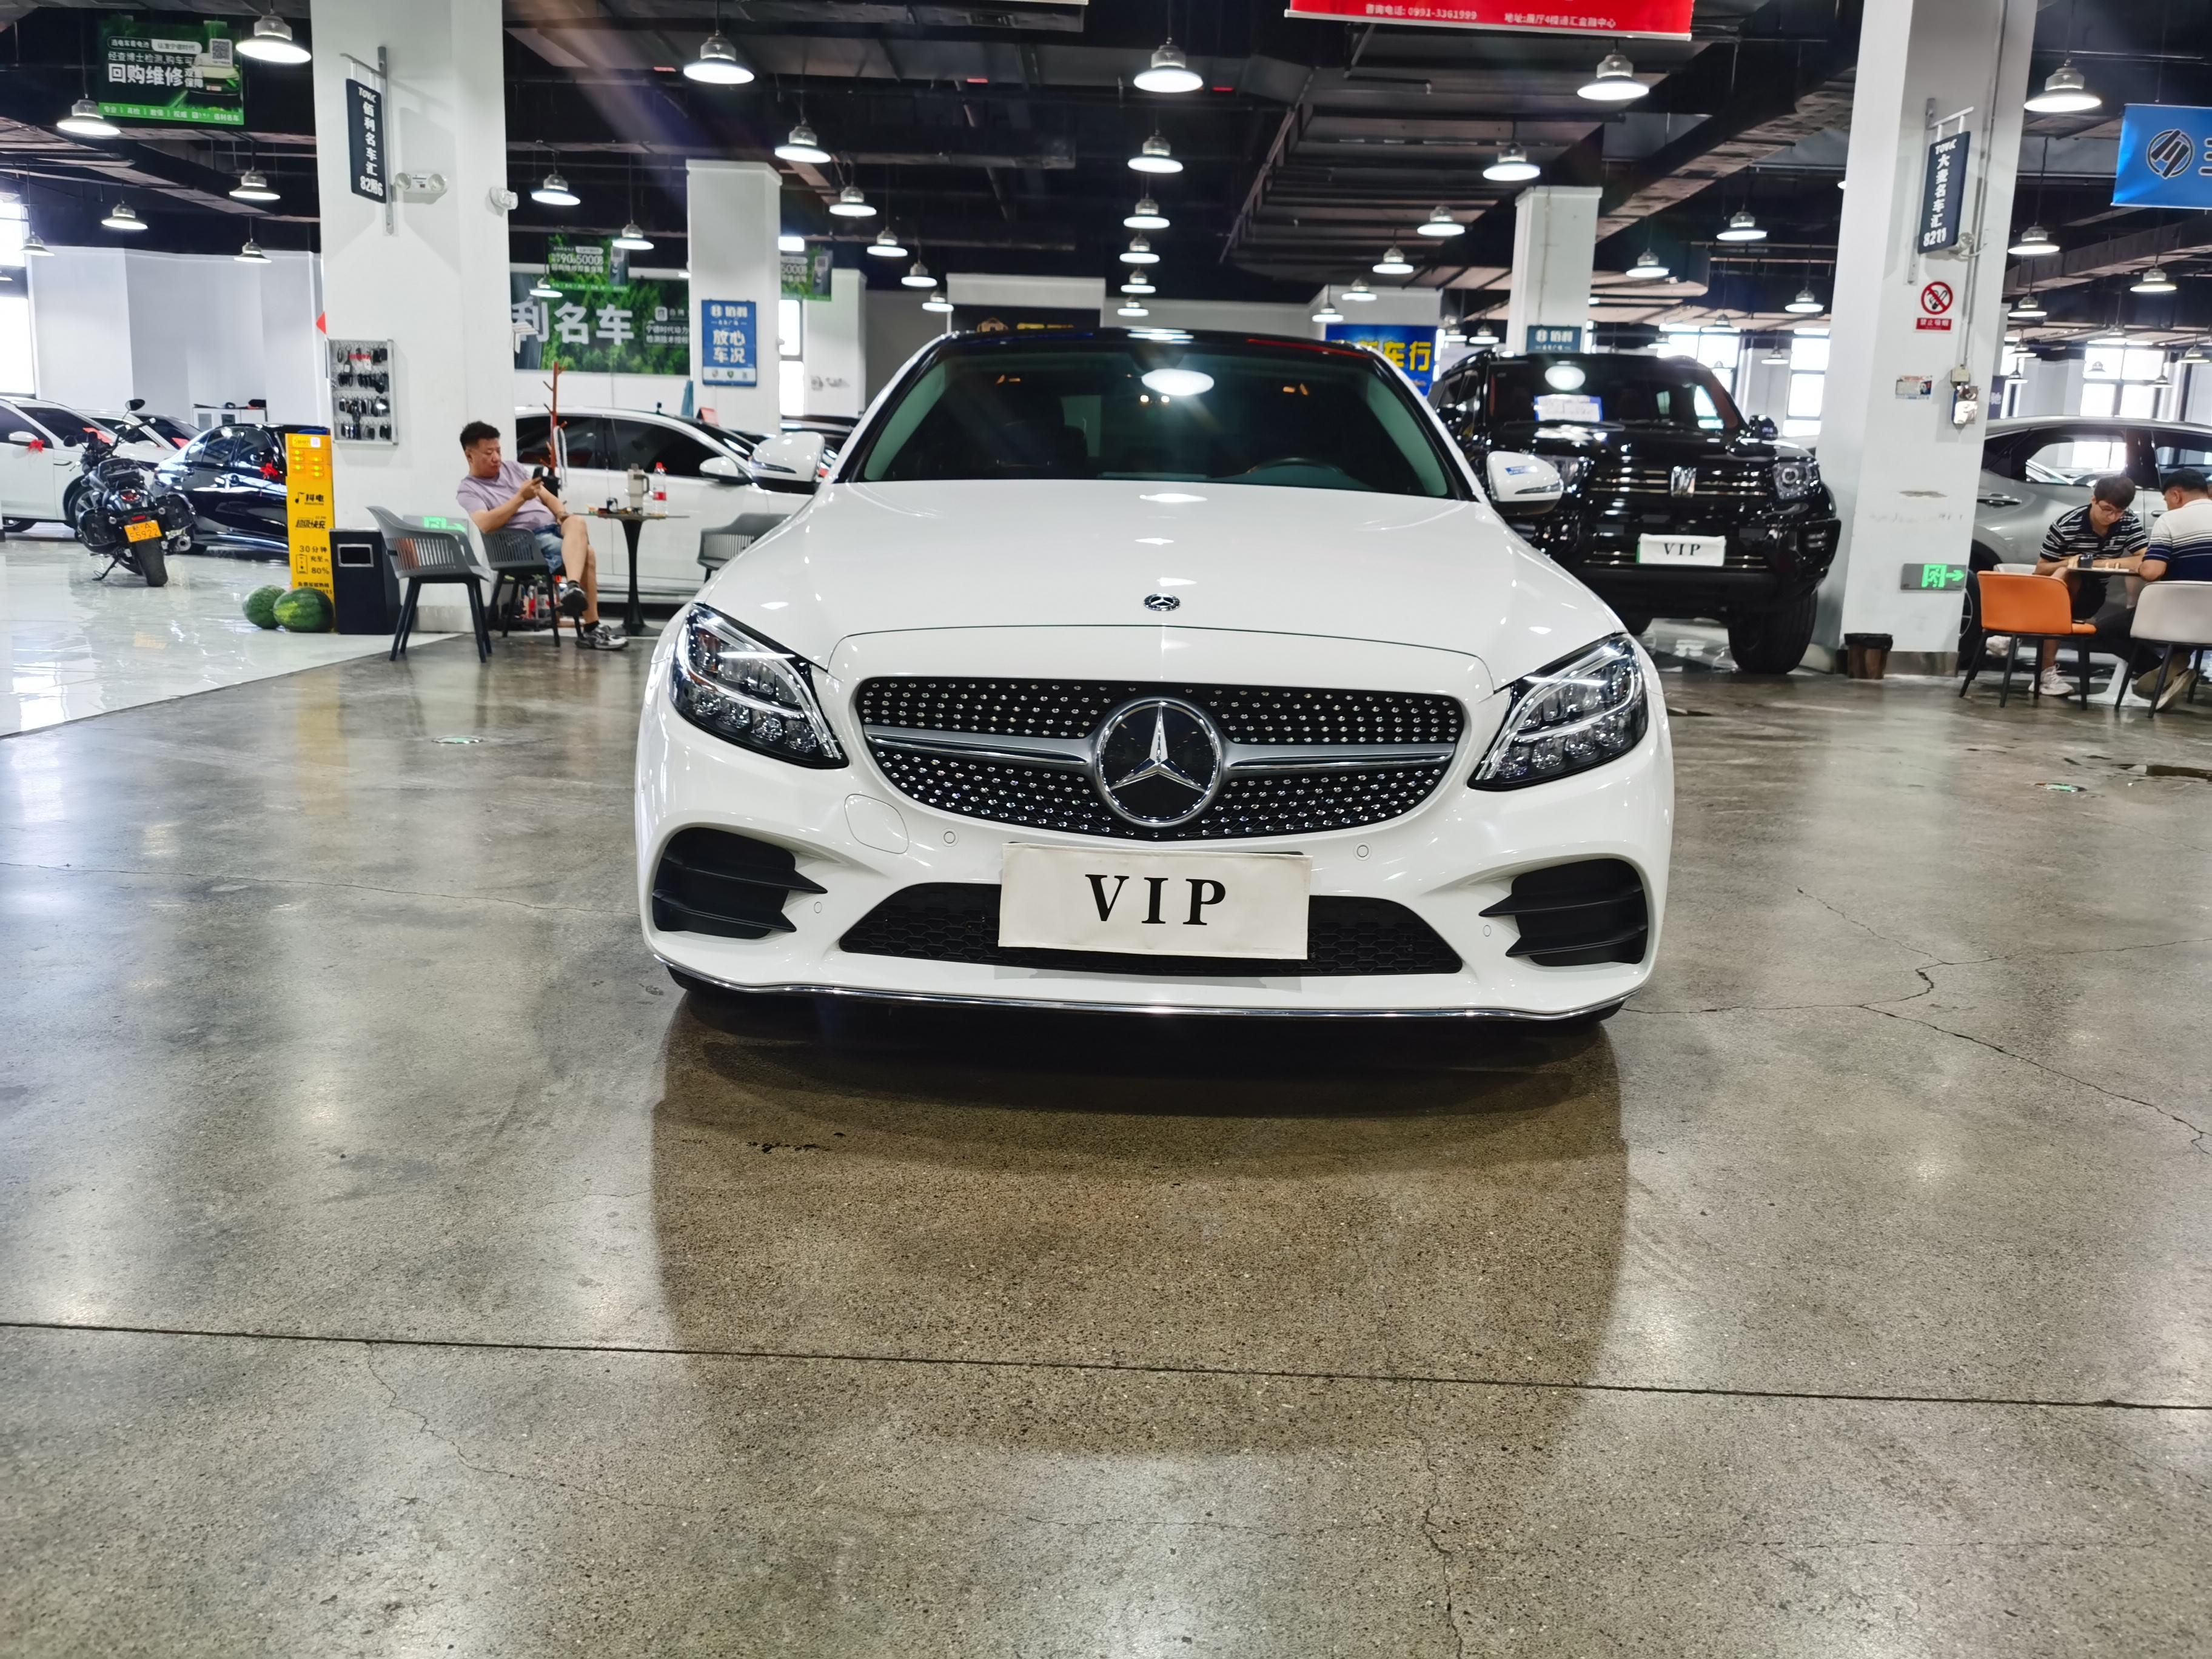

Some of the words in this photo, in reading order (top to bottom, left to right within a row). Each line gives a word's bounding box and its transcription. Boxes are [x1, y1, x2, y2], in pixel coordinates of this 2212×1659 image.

[108, 63, 184, 87] 回购维修
[362, 101, 378, 176] 佰利名车汇
[1923, 227, 1947, 247] 8211
[511, 295, 635, 346] 利名车
[712, 329, 746, 346] 放心
[712, 346, 746, 363] 车况
[1664, 543, 1701, 555] VIP
[1084, 873, 1227, 926] VIP
